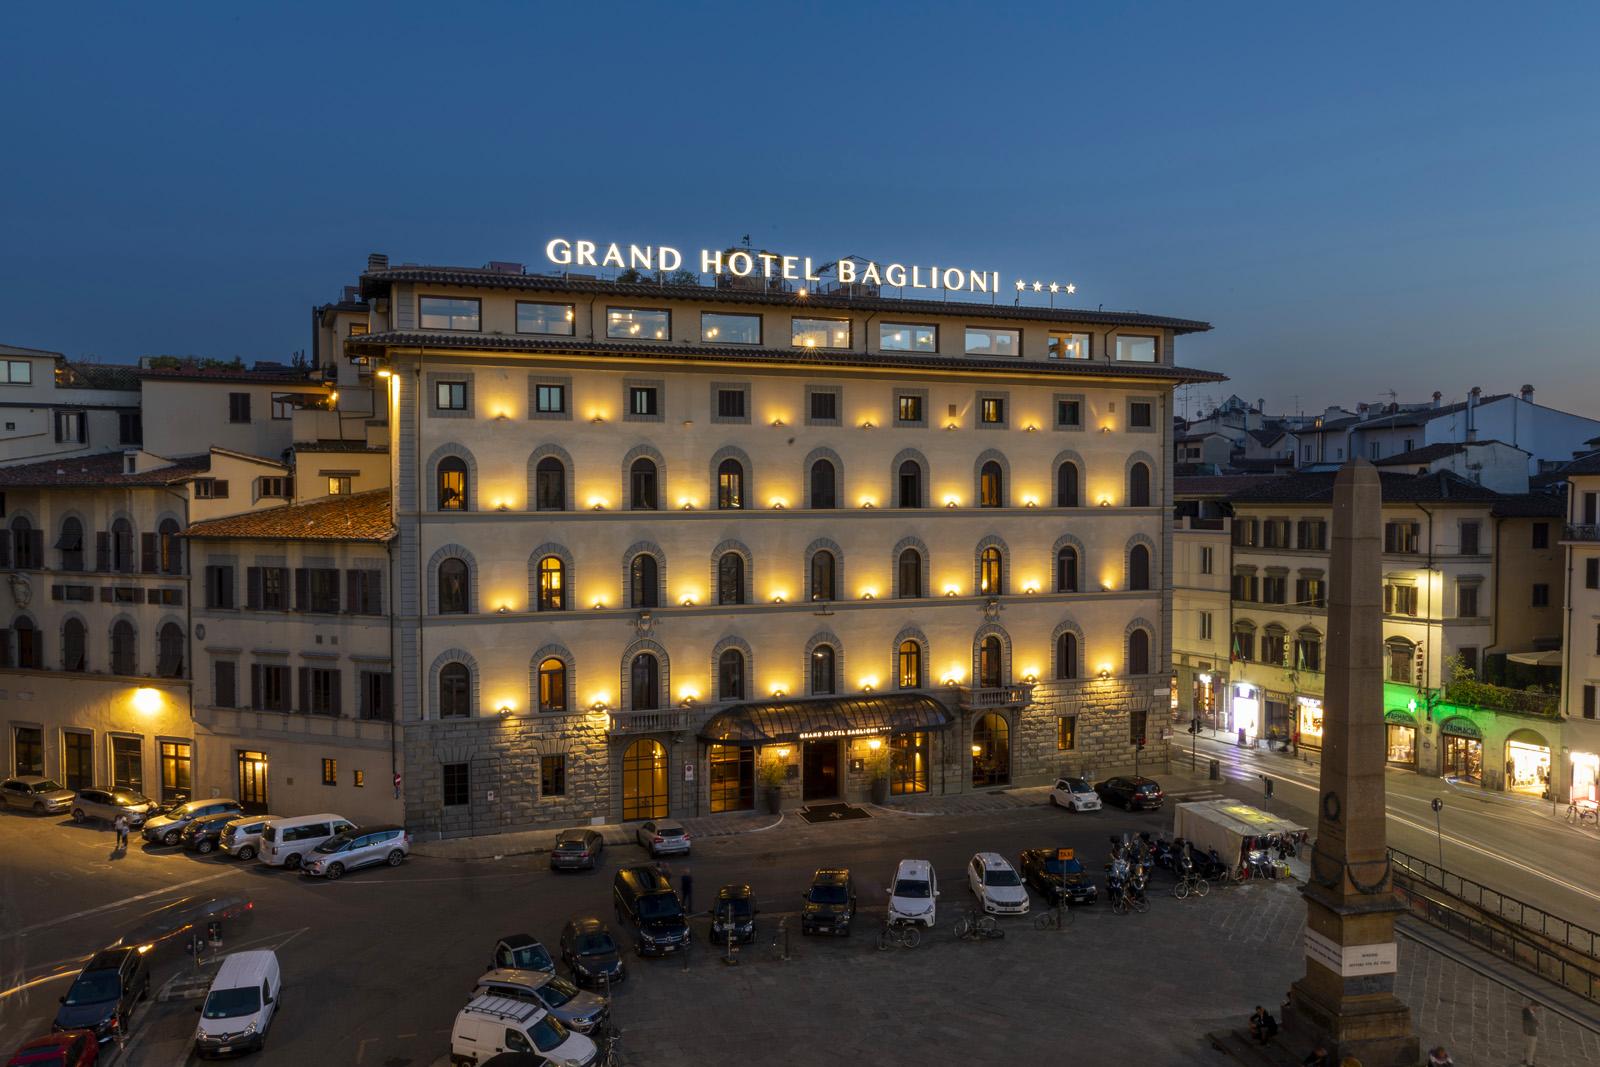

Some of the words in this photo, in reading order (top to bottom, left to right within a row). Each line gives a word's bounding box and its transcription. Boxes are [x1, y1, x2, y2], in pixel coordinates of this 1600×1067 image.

[546, 239, 682, 272] GRAND
[701, 249, 820, 282] HOTEL
[838, 260, 999, 294] BAGLIONI
[1416, 640, 1424, 694] FARMACIA
[1266, 692, 1286, 700] HOTEL
[1446, 724, 1478, 736] FARMACIA
